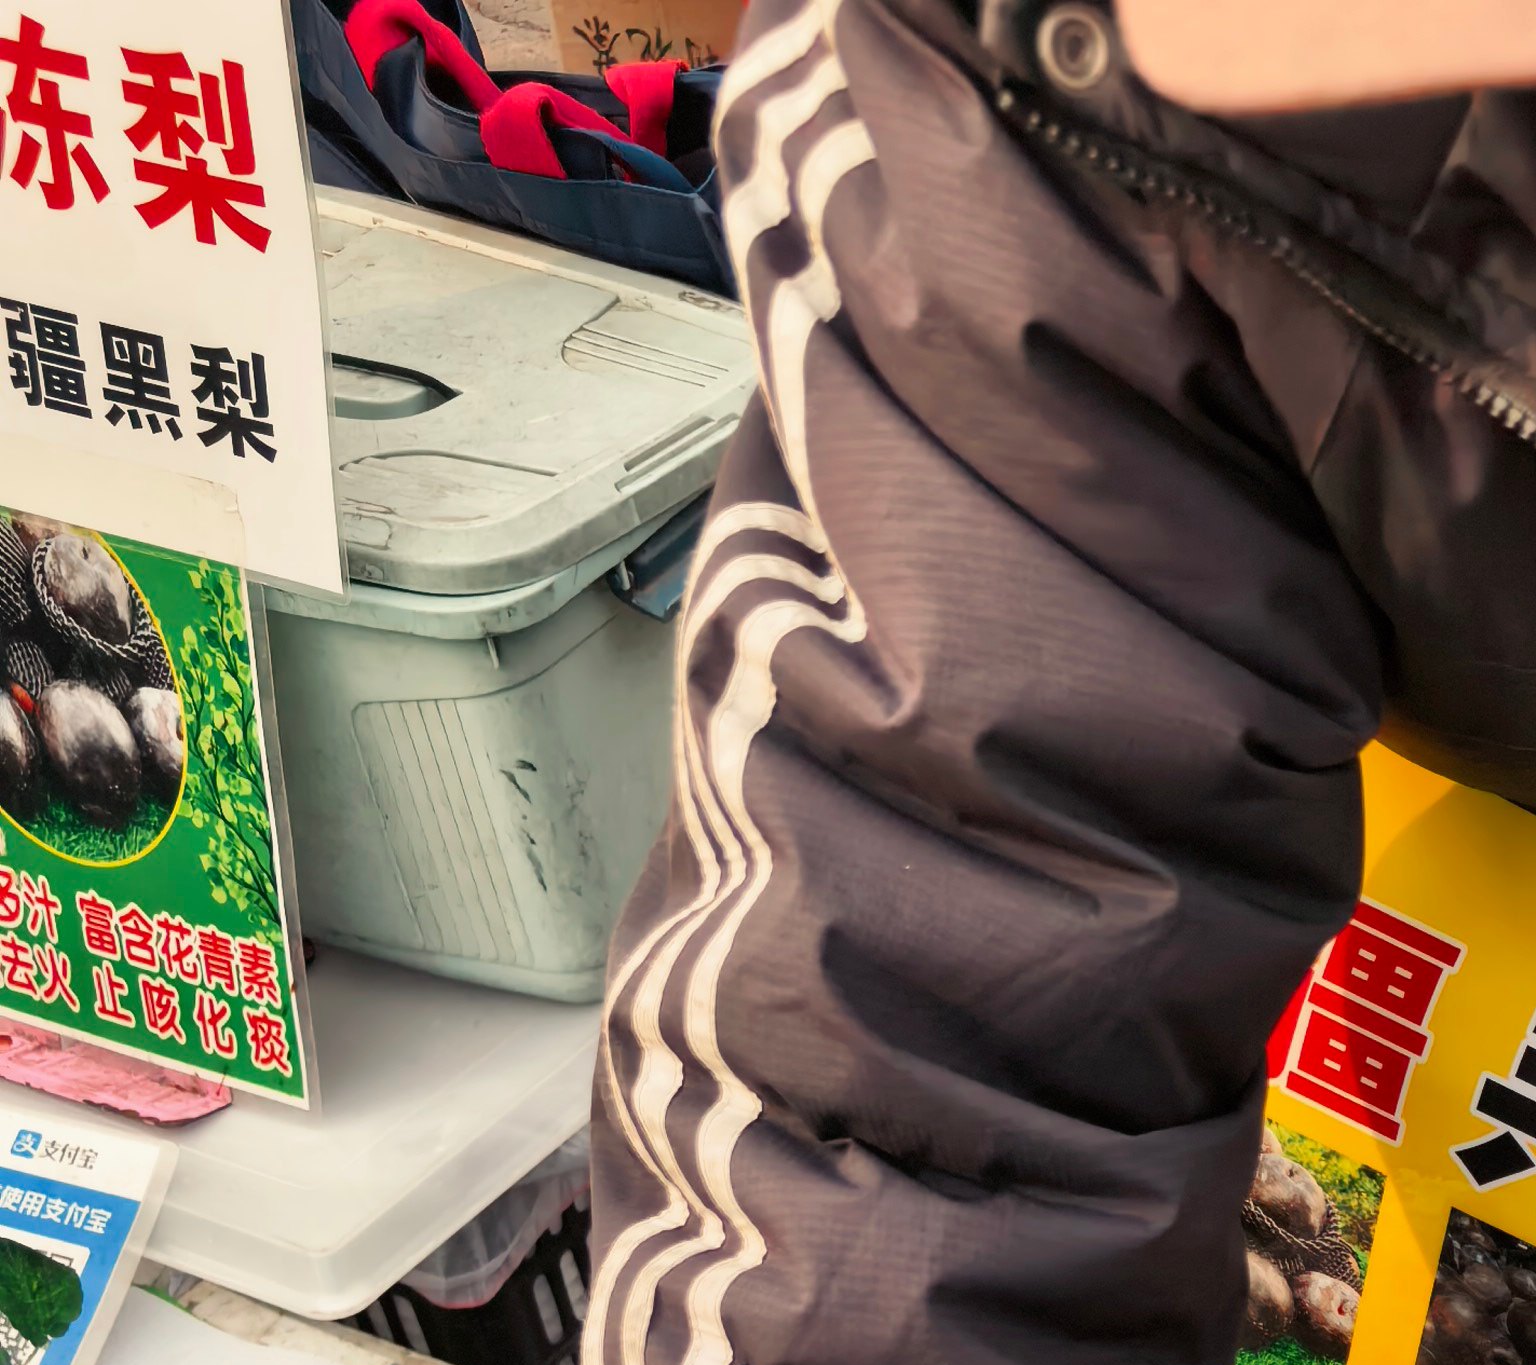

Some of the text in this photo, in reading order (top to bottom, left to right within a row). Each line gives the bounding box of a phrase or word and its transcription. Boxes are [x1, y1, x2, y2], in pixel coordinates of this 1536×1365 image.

[0, 300, 278, 464] 疆黑梨
[77, 891, 280, 1005] 富含花青素
[94, 964, 291, 1073] 止咳化痰
[38, 1138, 99, 1171] 支付宝
[0, 1184, 113, 1235] 使用支付宝
